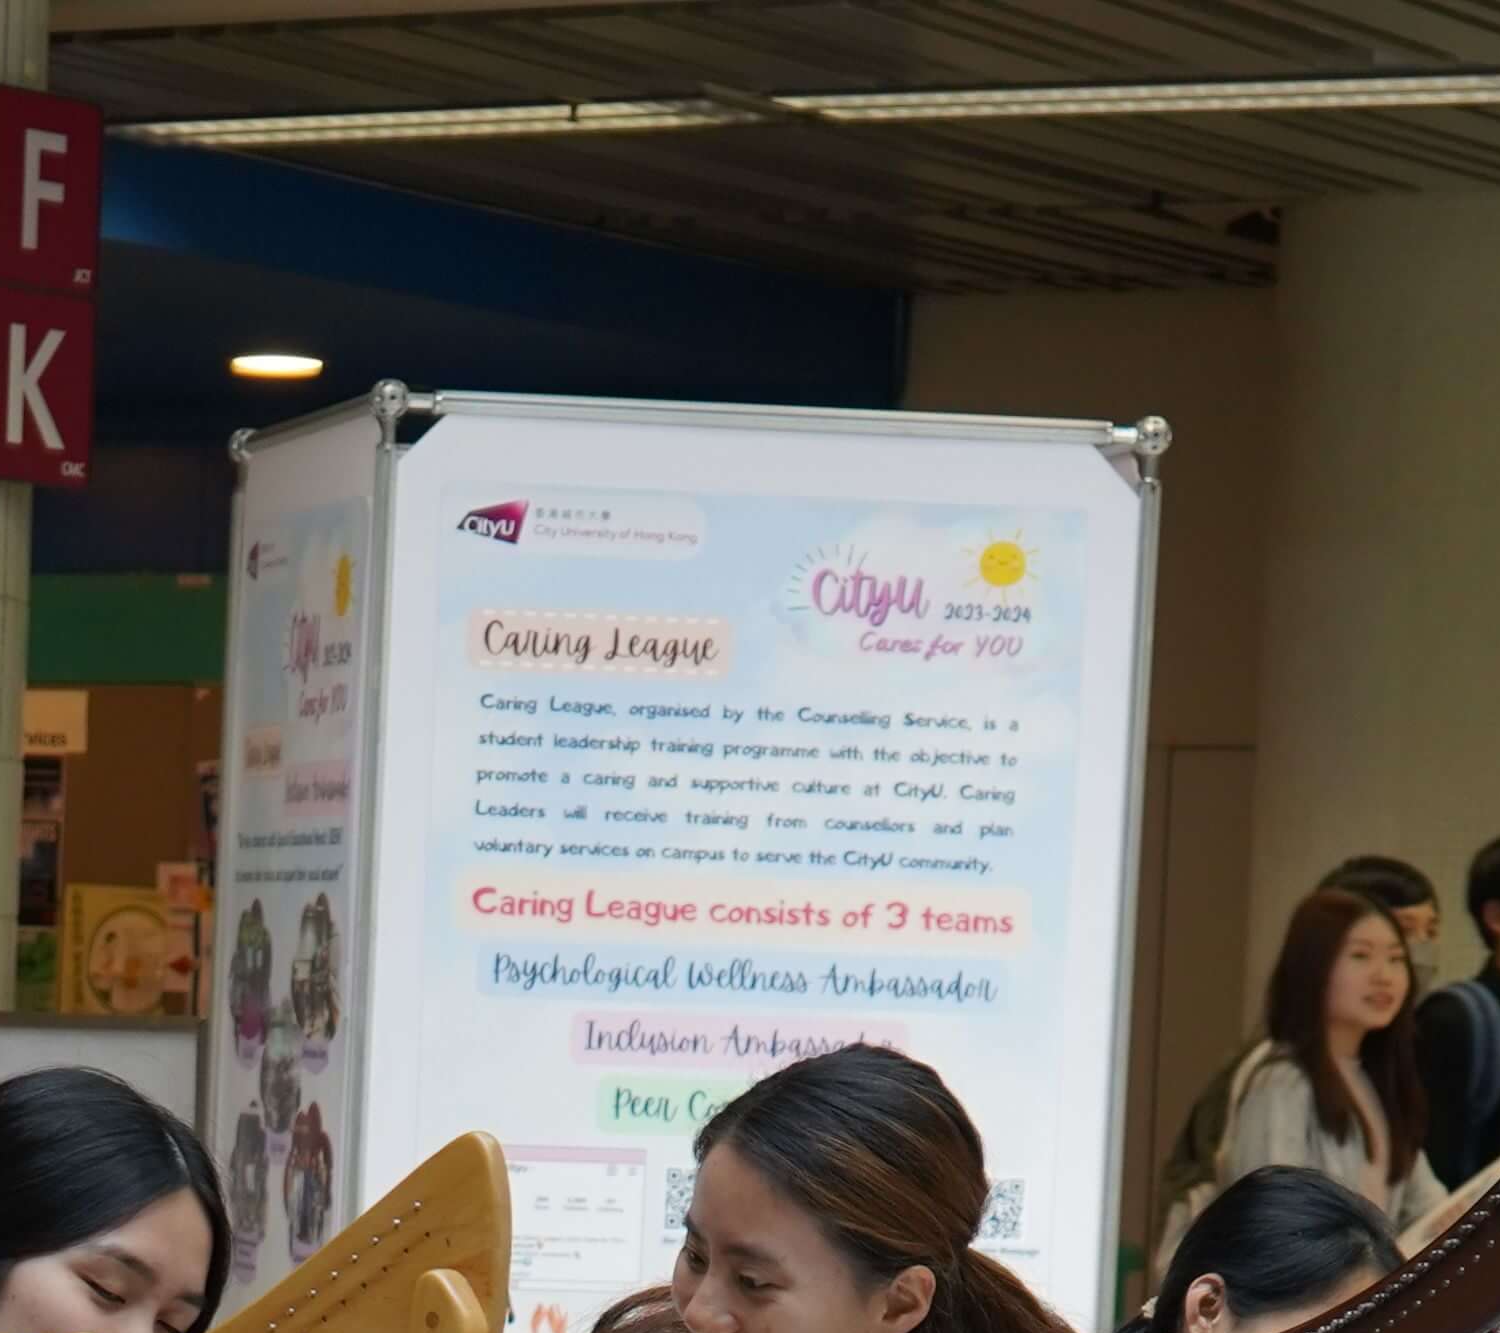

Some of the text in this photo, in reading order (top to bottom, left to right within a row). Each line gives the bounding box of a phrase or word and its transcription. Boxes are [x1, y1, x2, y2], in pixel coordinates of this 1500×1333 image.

[21, 127, 68, 250] F
[5, 322, 66, 450] K
[484, 623, 718, 667] Caring League
[480, 693, 537, 714] Caring
[629, 705, 710, 719] organised
[723, 706, 744, 724] by
[757, 707, 784, 721] the
[797, 707, 890, 729] Counselling
[984, 720, 996, 730] is
[1009, 721, 1018, 731] a
[472, 887, 1012, 933] Caring League consists of 3 teams
[494, 952, 997, 1004] Psychological Wellness Ambassador
[584, 1019, 713, 1056] Inclusion
